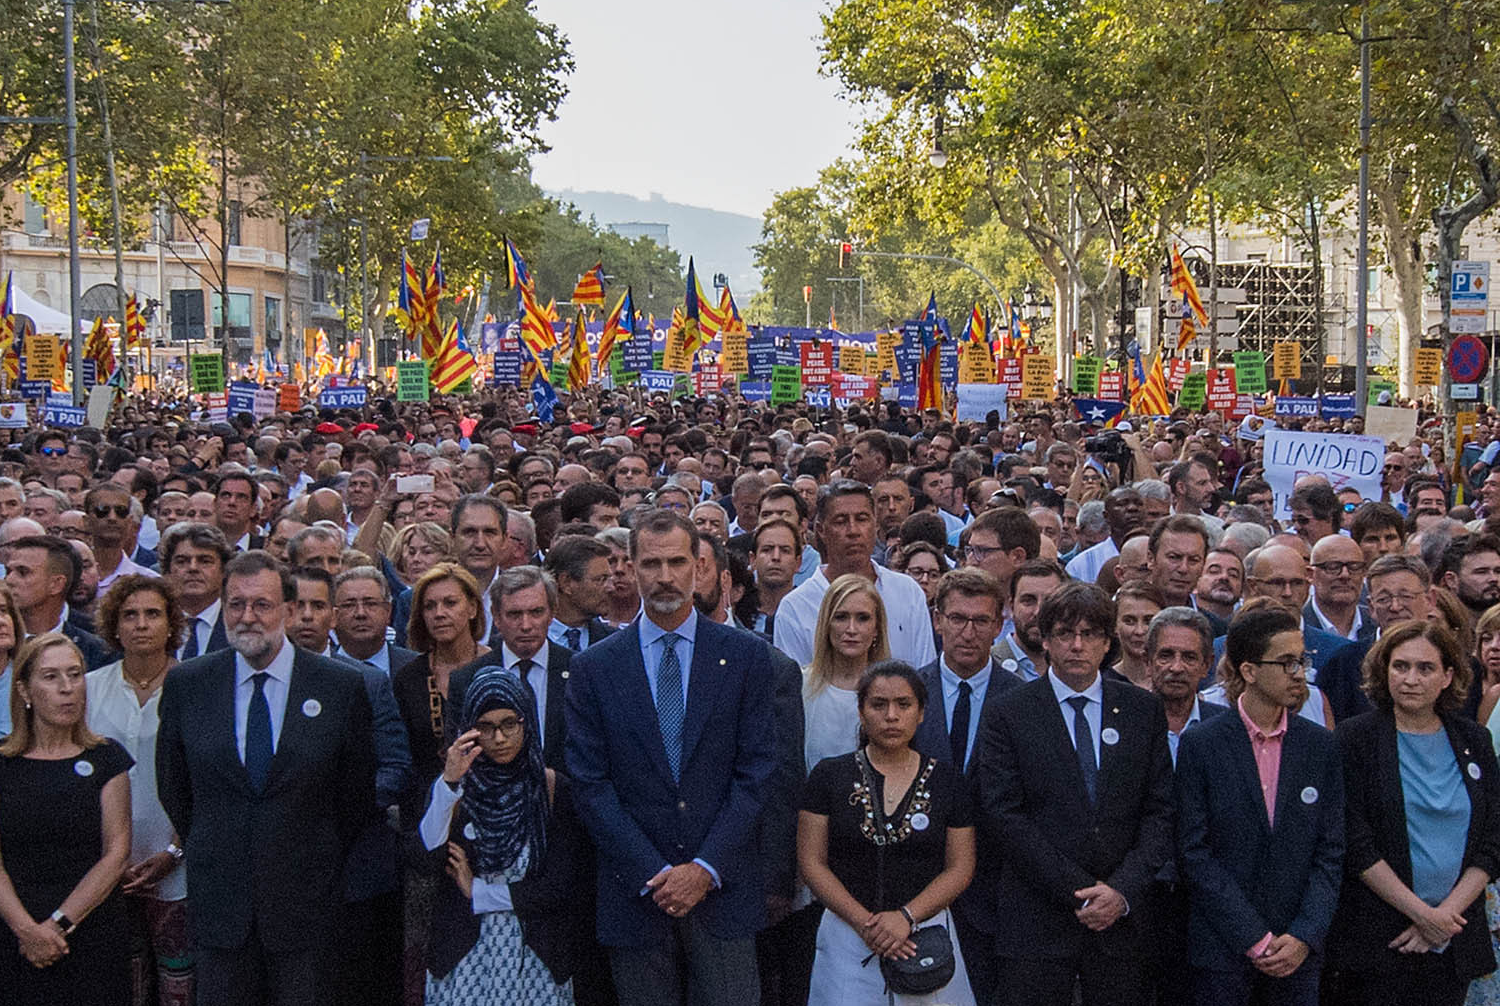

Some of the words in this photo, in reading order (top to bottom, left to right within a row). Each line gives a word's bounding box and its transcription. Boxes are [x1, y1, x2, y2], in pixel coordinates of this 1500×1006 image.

[1456, 275, 1466, 291] P
[652, 378, 674, 387] PAU
[321, 395, 337, 405] LA
[341, 394, 367, 405] PAU
[1276, 405, 1290, 414] LA
[1294, 405, 1317, 415] PAU
[59, 412, 85, 426] PAU
